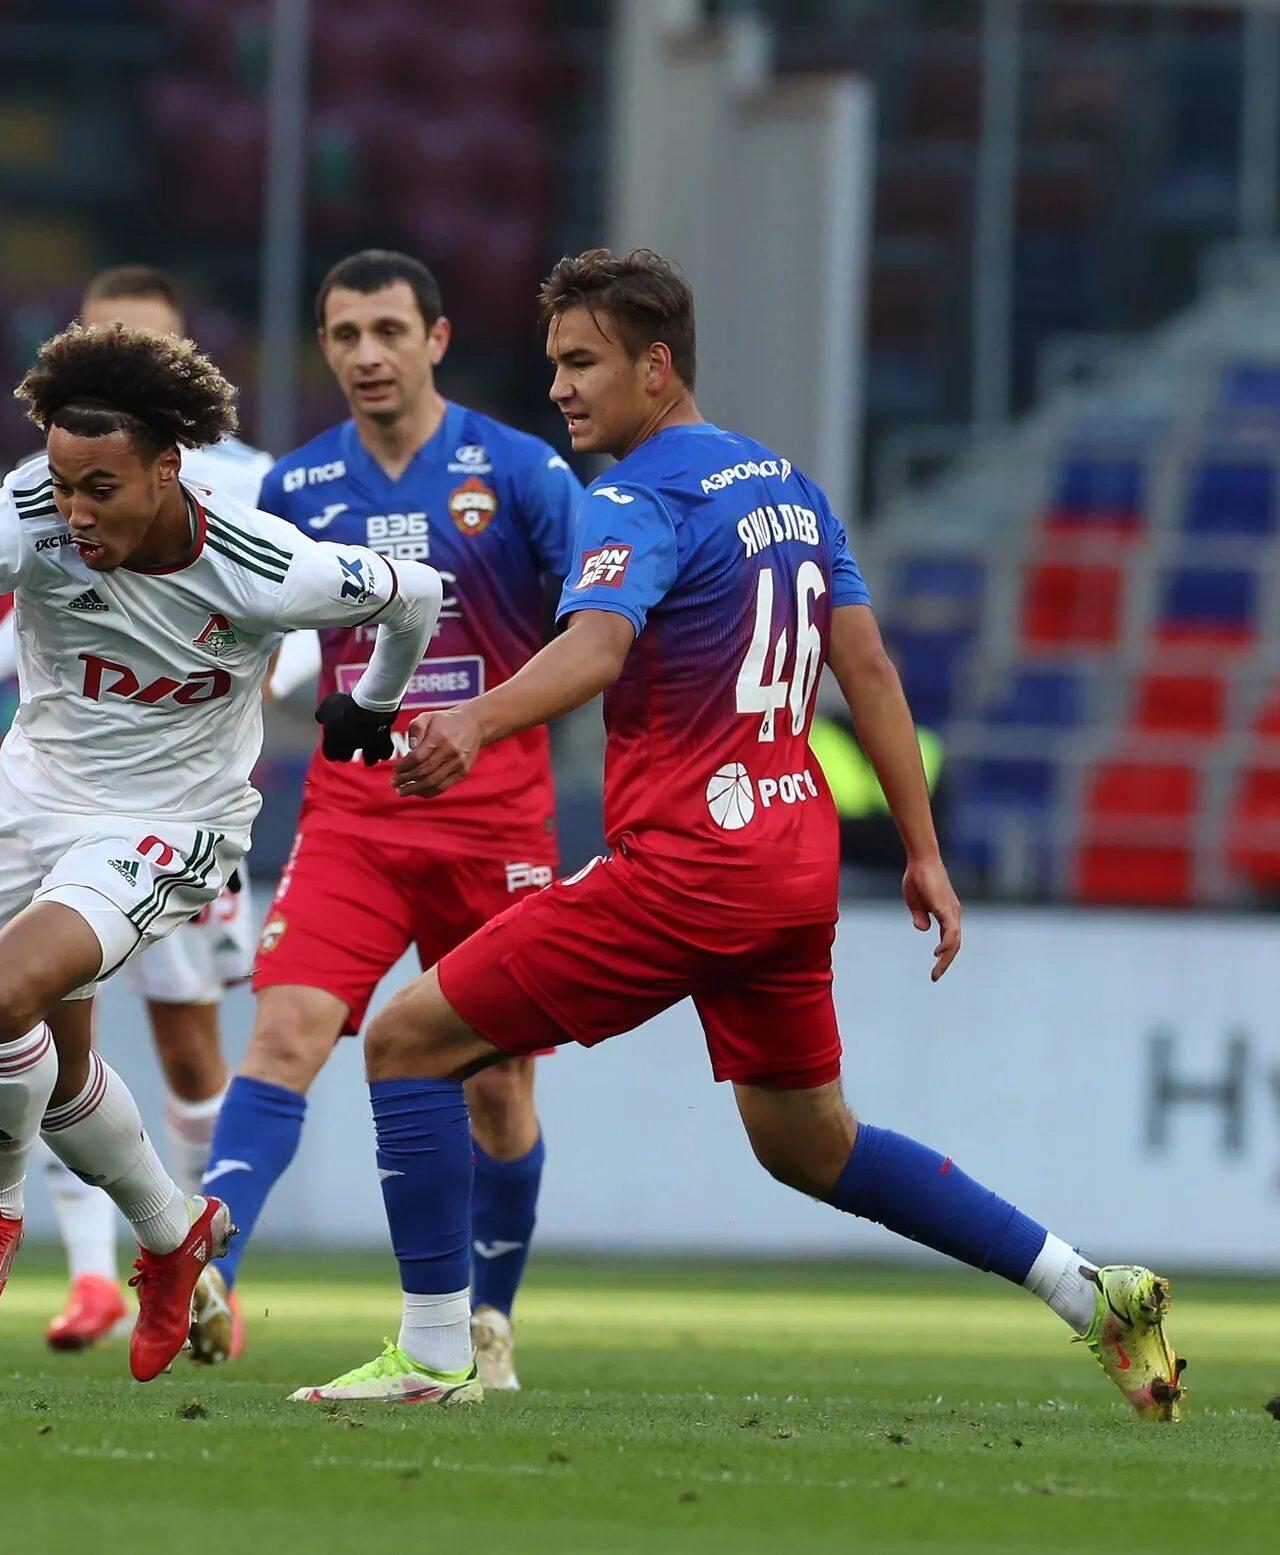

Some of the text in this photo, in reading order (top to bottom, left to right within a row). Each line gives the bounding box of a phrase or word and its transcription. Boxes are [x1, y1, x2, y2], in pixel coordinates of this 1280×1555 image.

[367, 512, 429, 538] ВЭБ
[737, 504, 820, 558] ЯКОВЛЕВ
[582, 549, 629, 575] FON
[575, 565, 624, 590] BET
[68, 601, 110, 612] adidas
[736, 561, 826, 742] 46
[107, 859, 138, 887] adidas
